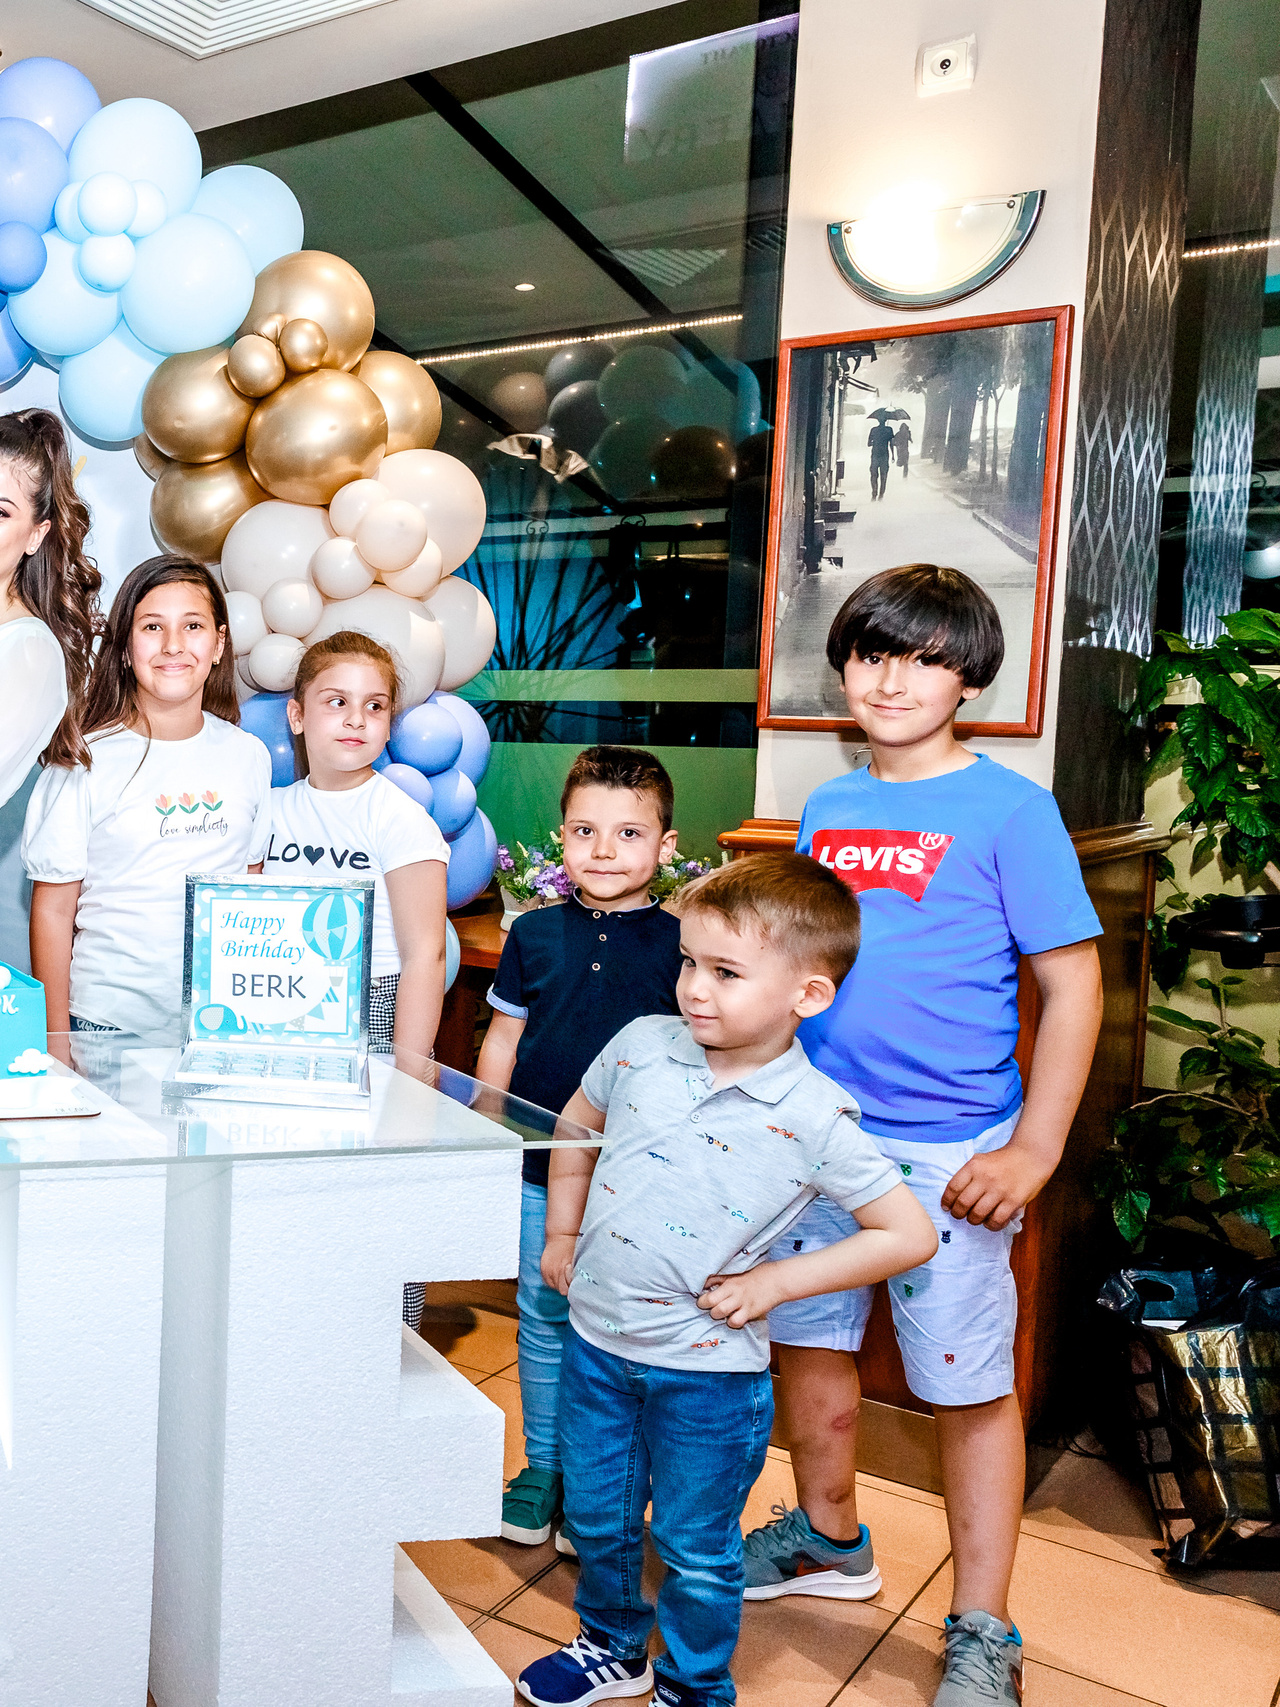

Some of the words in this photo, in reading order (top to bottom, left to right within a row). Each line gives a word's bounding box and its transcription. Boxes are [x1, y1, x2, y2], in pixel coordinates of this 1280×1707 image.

[159, 816, 180, 838] love
[184, 812, 228, 837] simplicity
[220, 910, 285, 935] Happy
[220, 939, 306, 966] Birthday
[231, 973, 306, 999] BERK
